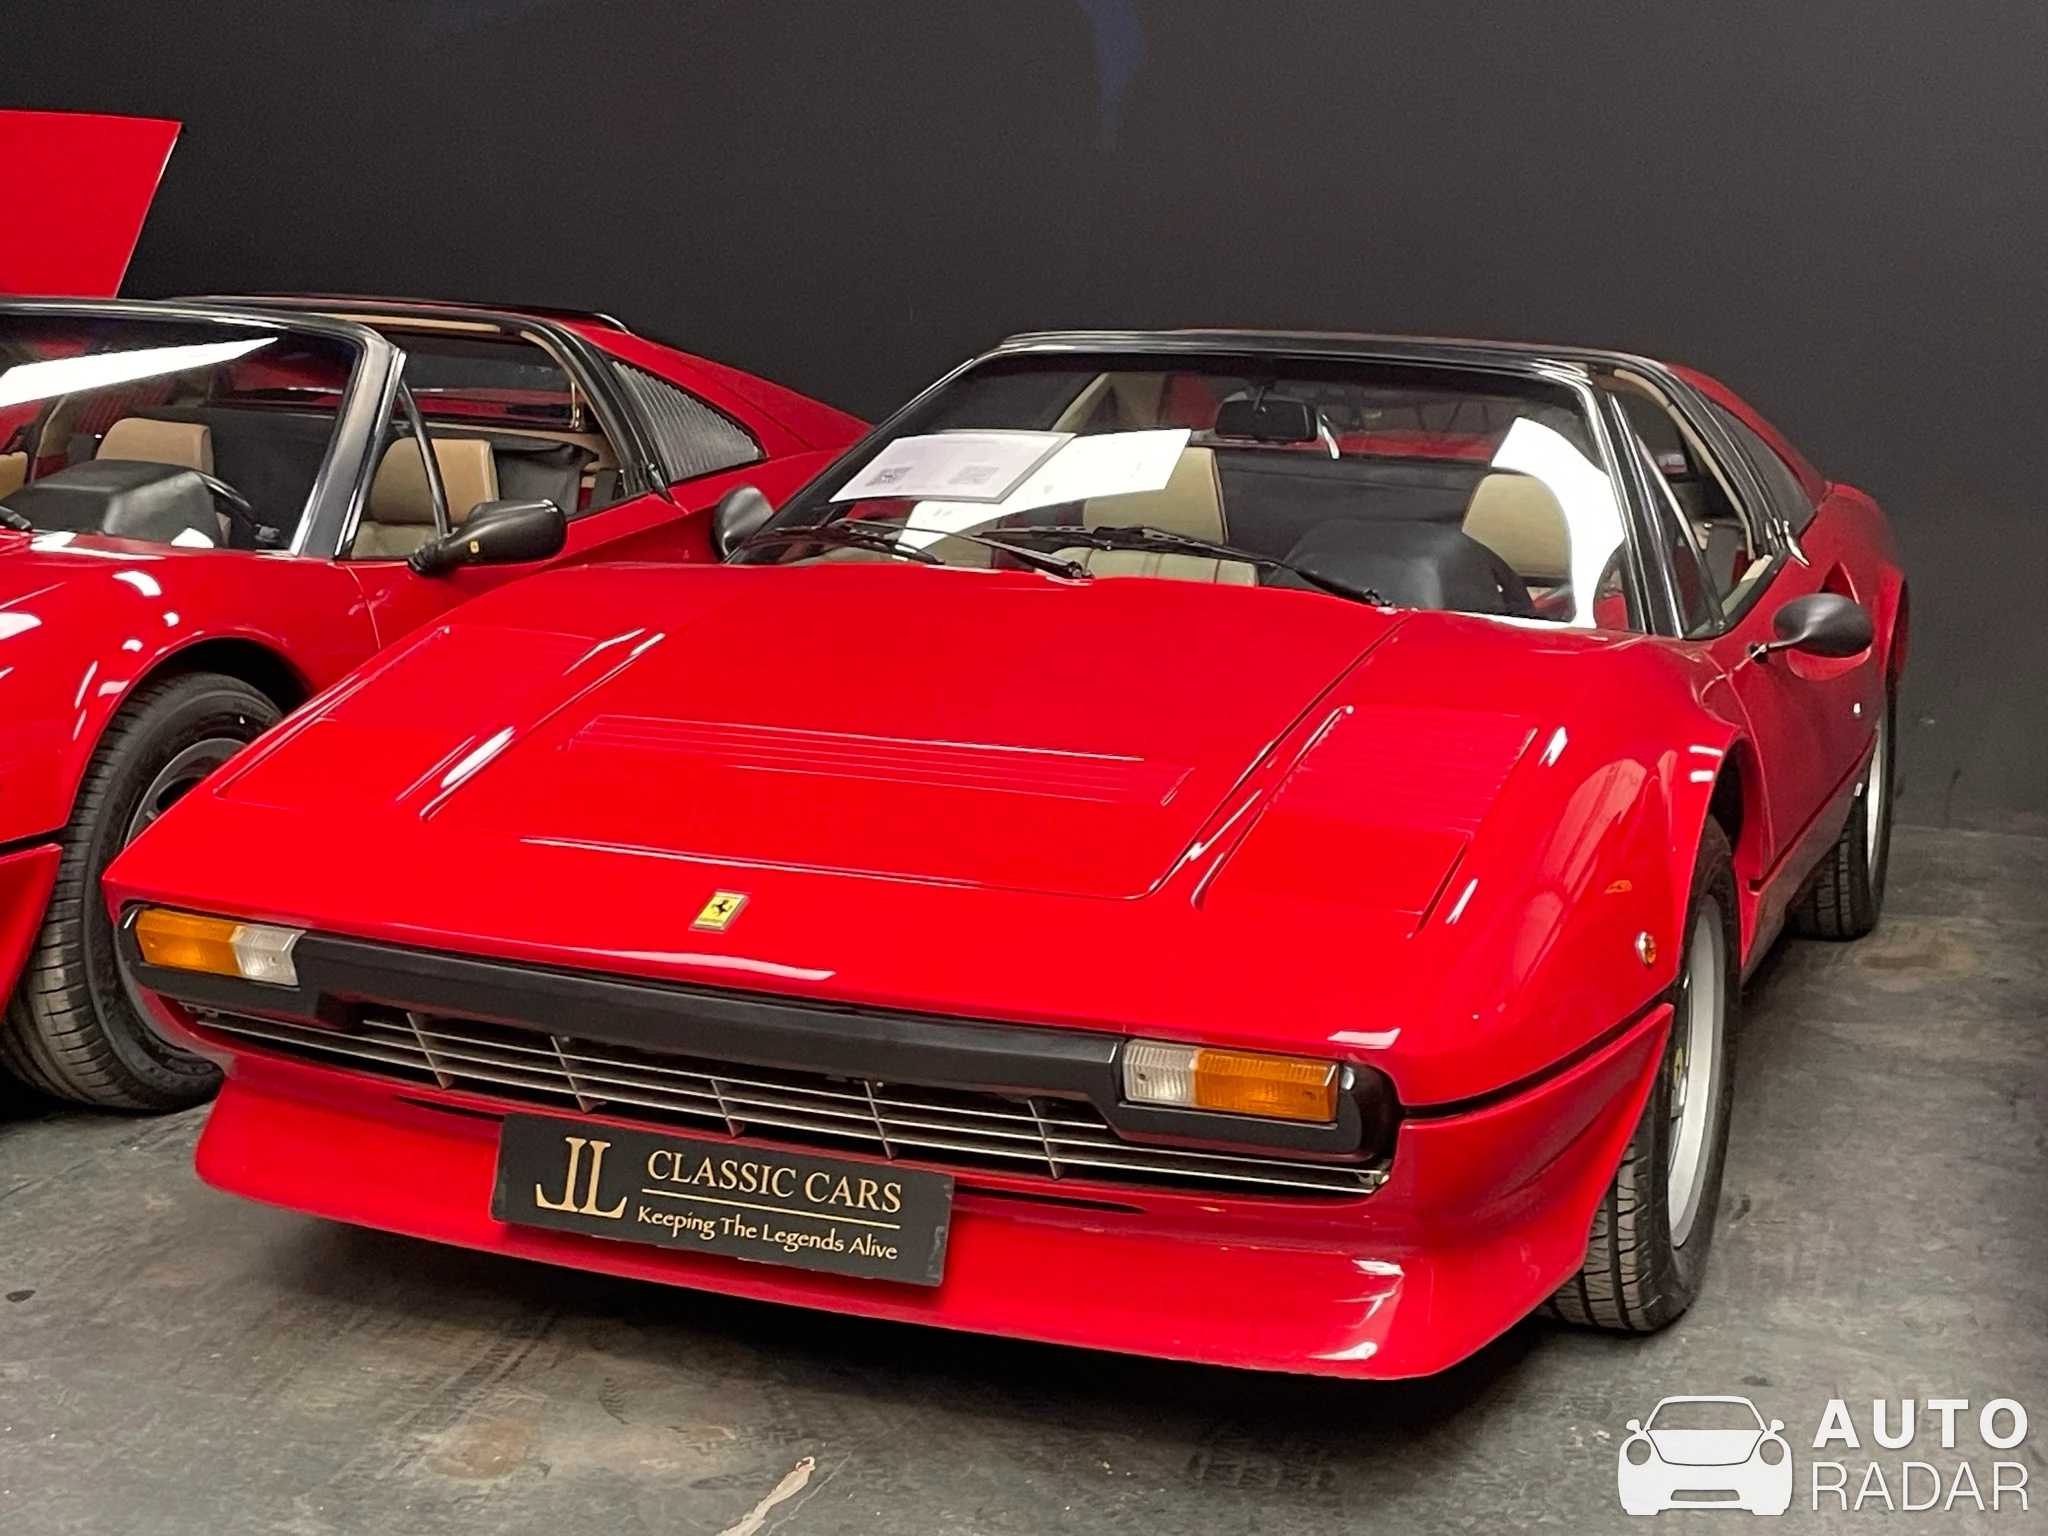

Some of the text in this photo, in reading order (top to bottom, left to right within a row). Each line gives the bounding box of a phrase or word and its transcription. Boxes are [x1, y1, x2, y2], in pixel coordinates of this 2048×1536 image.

[647, 1149, 902, 1214] CLASSIC CARS
[637, 1206, 898, 1261] Keeping The Legends Alive
